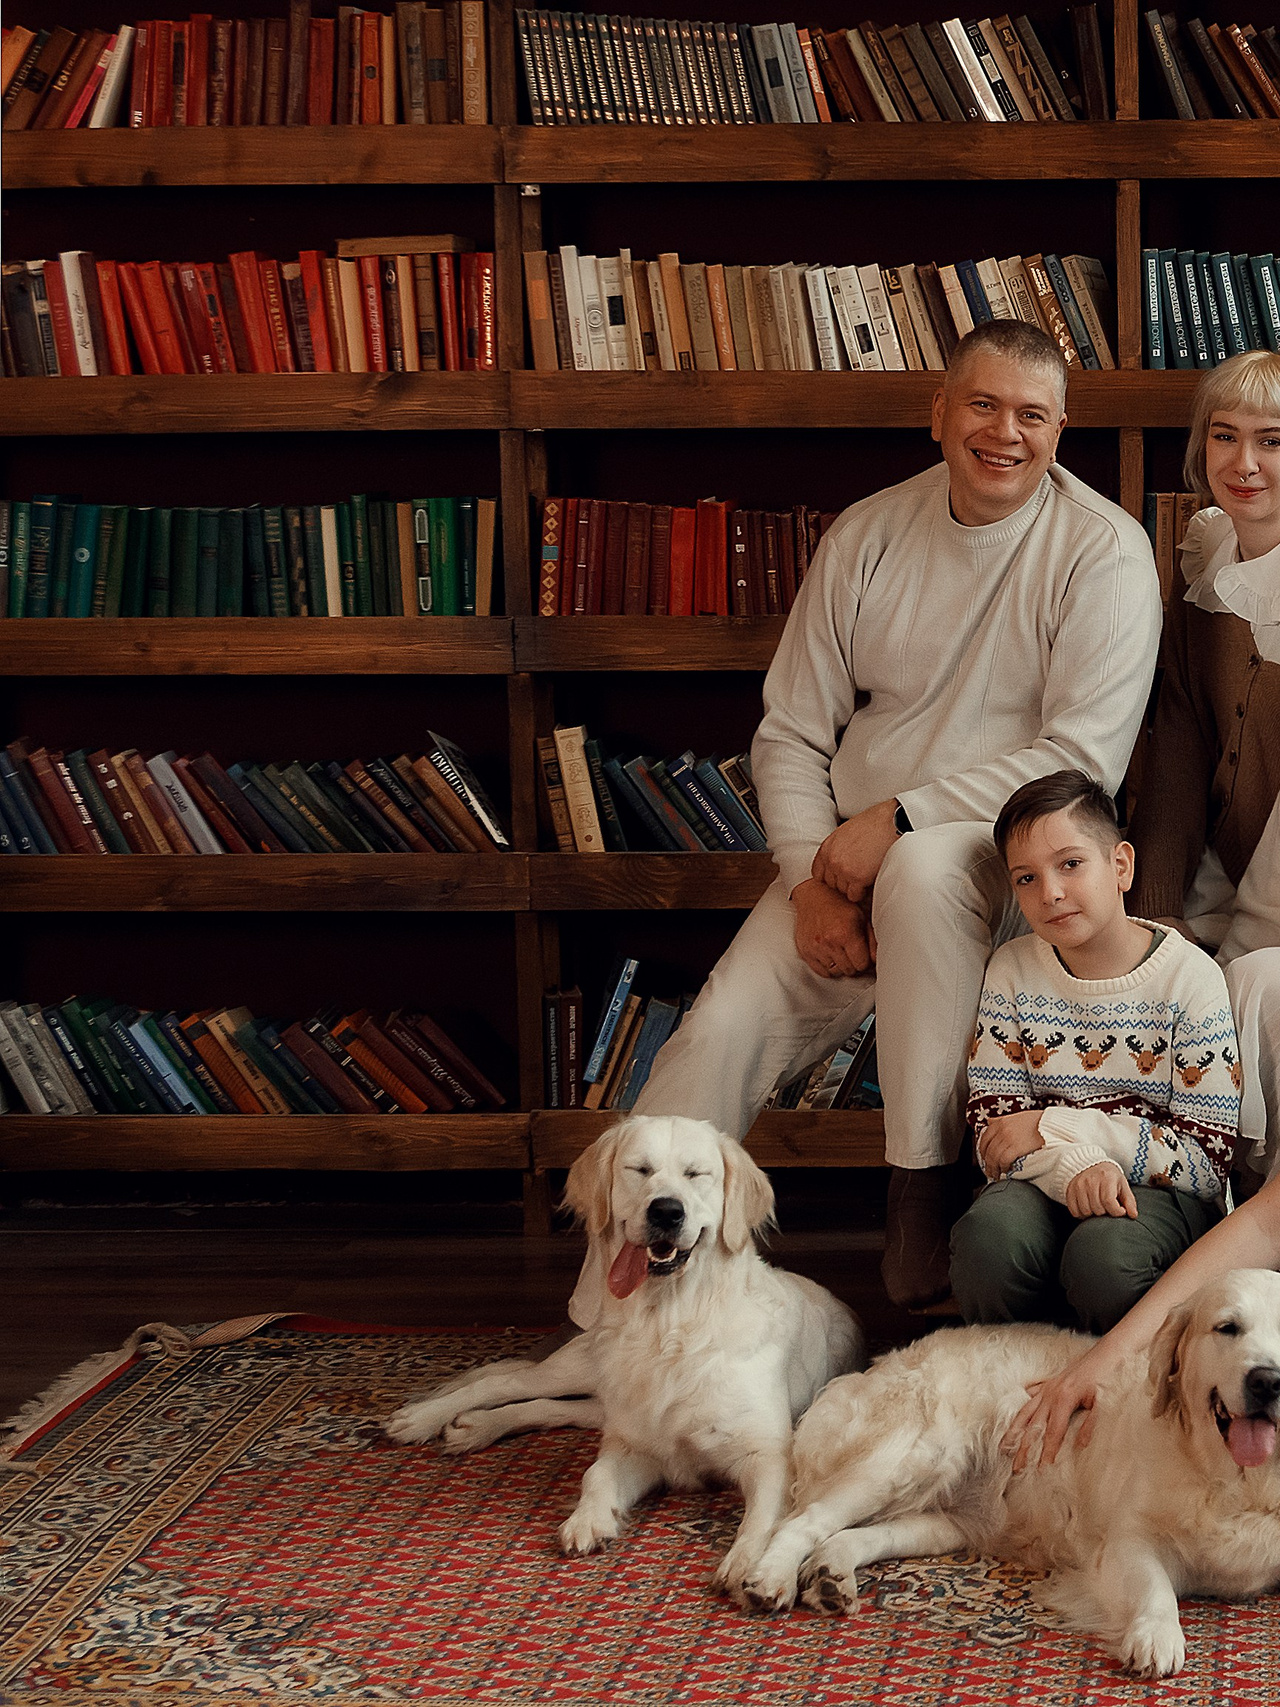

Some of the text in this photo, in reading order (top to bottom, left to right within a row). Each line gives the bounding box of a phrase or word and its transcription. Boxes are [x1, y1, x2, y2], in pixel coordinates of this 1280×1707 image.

[1153, 22, 1174, 68] СИМОНОВ
[482, 275, 492, 322] АЭРОПОРТ
[1049, 261, 1071, 303] СОБОЛЕВ
[1147, 258, 1158, 321] ГОЛСУОРСИ
[1164, 260, 1182, 322] ГОЛСУОРСИ
[1185, 263, 1202, 325] ГОЛСУОРСИ
[1219, 262, 1245, 350] ДЖОН ГОЛСУОРСИ
[371, 333, 383, 364] ПАВЕЛ
[1151, 321, 1161, 349] ДЖОН
[1176, 322, 1188, 349] ДЖОН
[1195, 325, 1207, 351] ДЖОН
[549, 1007, 557, 1054] строительстве
[600, 1013, 616, 1045] DEUTSCH
[550, 1082, 558, 1106] Оплата
